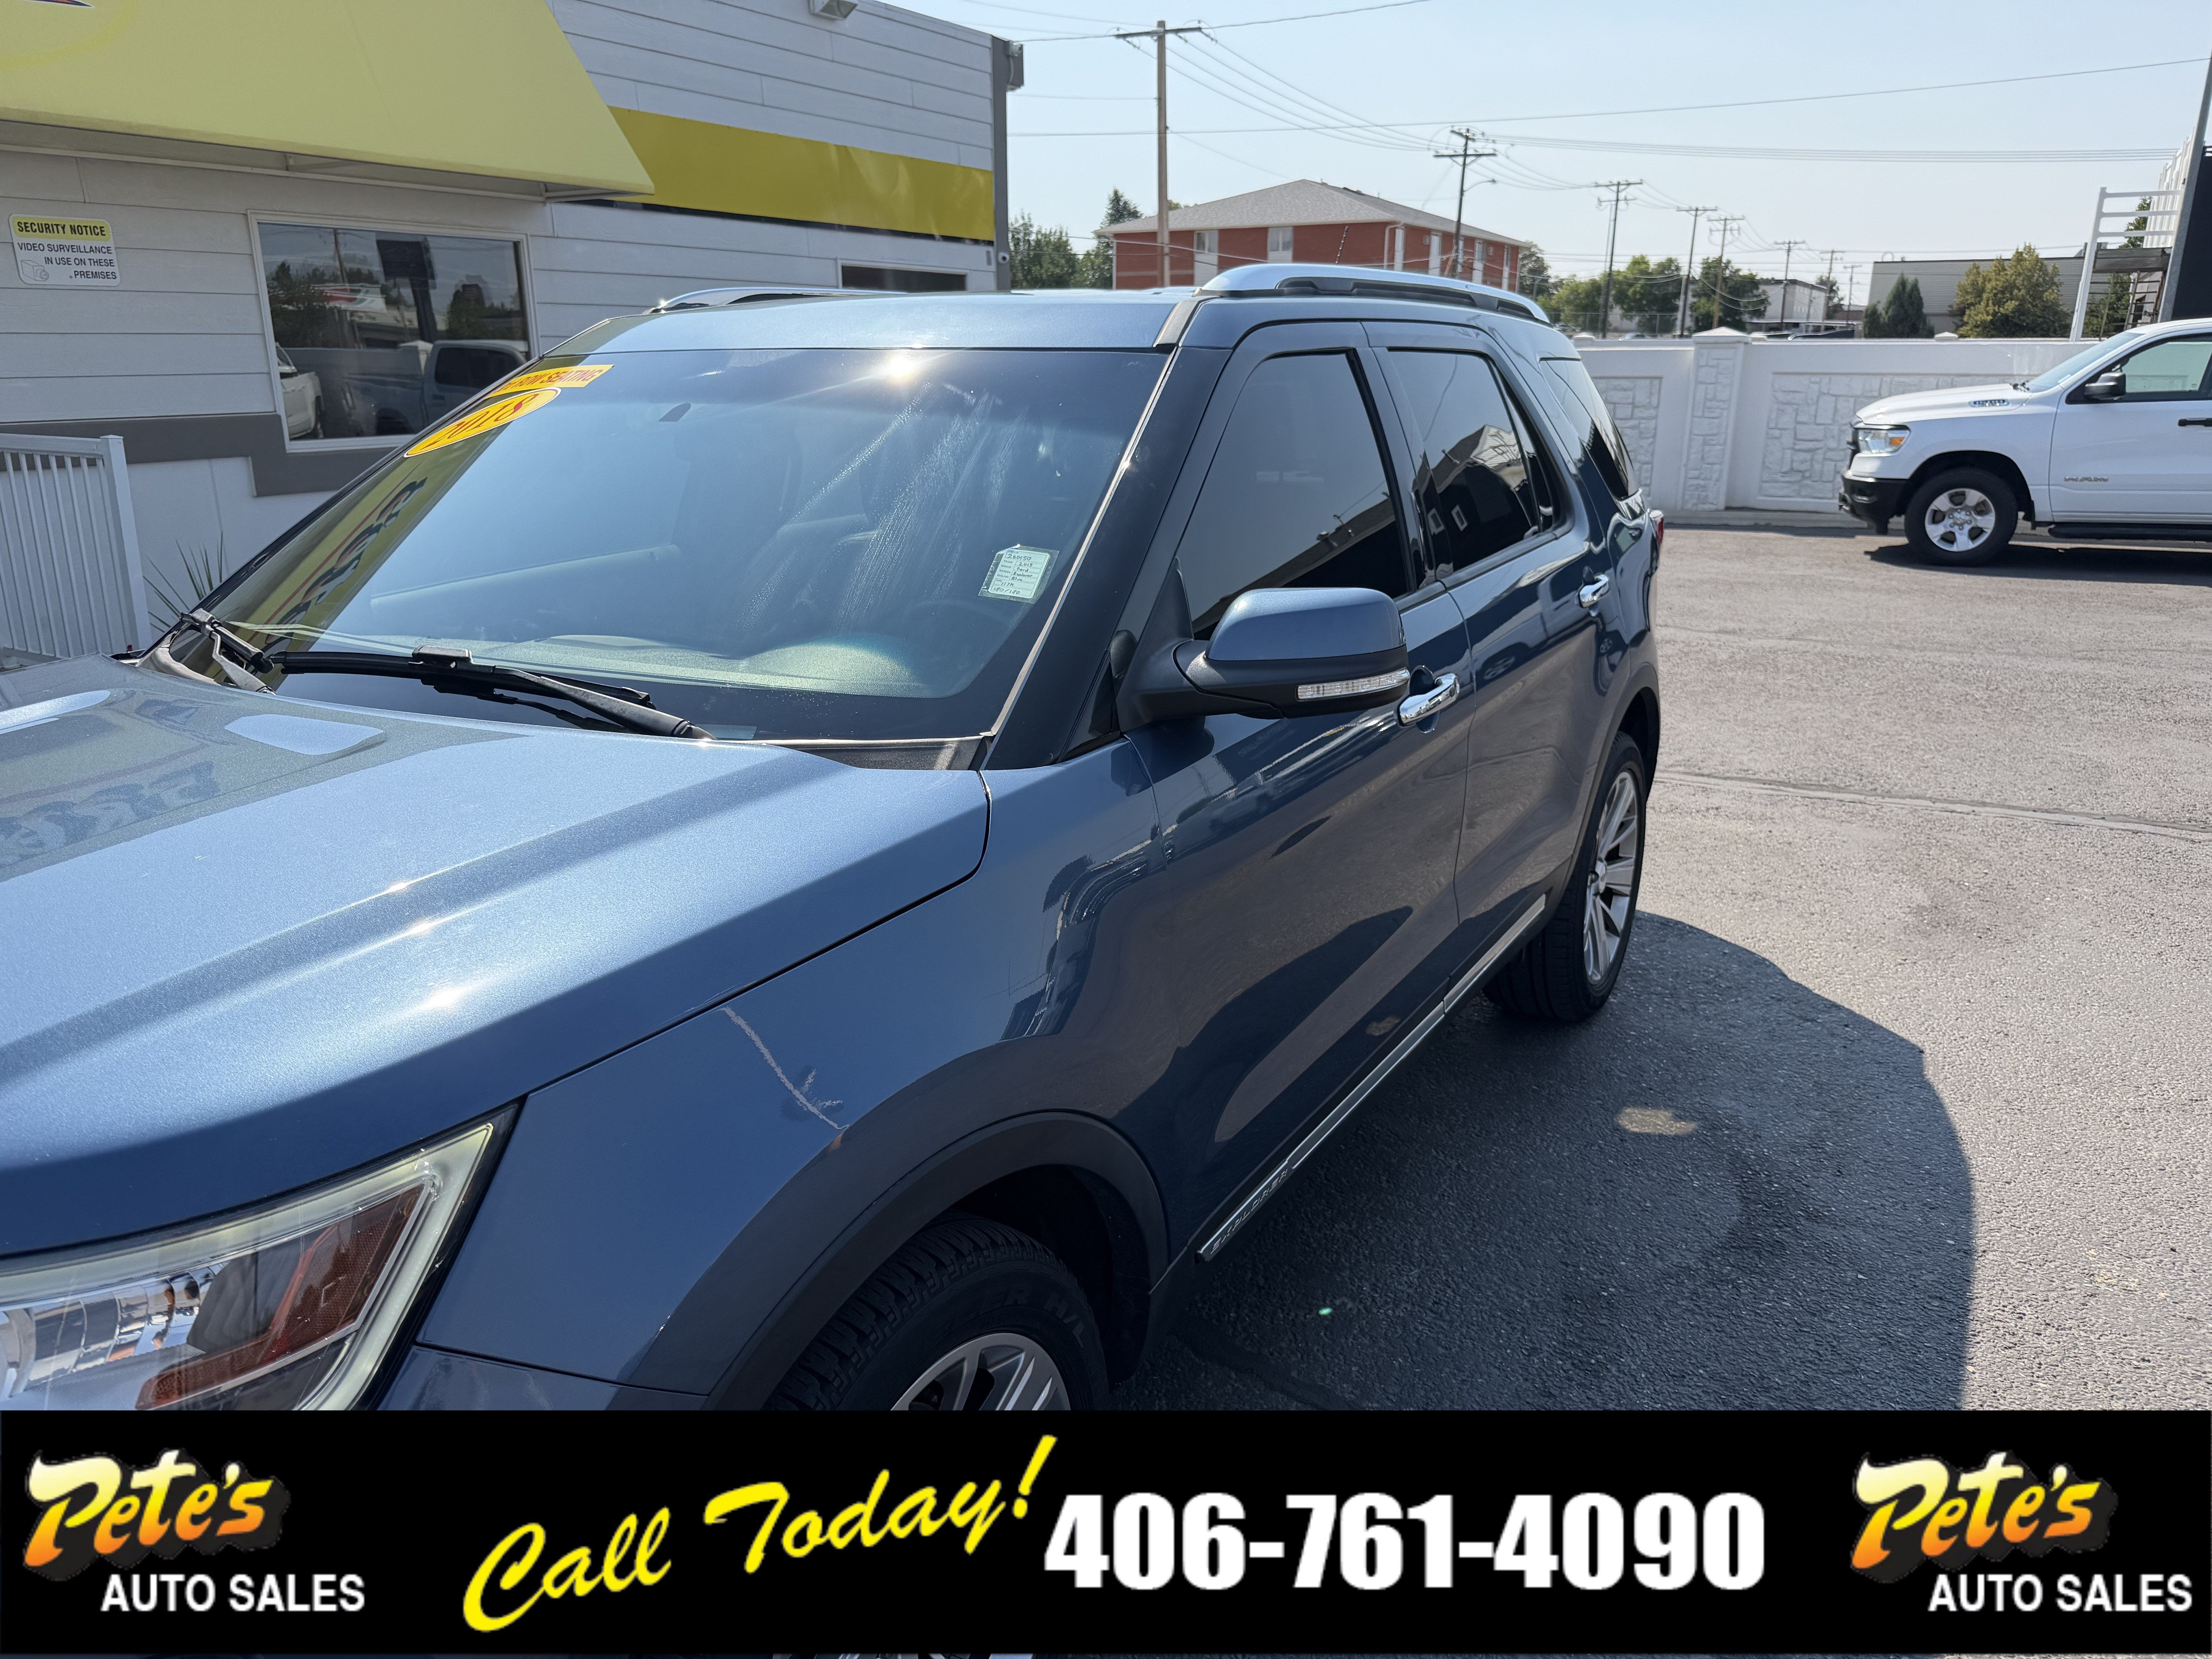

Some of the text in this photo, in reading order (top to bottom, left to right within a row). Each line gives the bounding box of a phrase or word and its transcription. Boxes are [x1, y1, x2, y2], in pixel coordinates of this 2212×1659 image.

[17, 222, 106, 236] SECURITY NOTICE
[17, 242, 112, 254] VIDEO SURVEILLANCE
[45, 257, 53, 265] IN
[74, 258, 86, 266] ON
[88, 258, 115, 267] THESE
[74, 270, 117, 280] PREMISES
[539, 369, 604, 384] SEATING
[419, 393, 539, 451] 2018
[1210, 1169, 1288, 1254] EXPLORER
